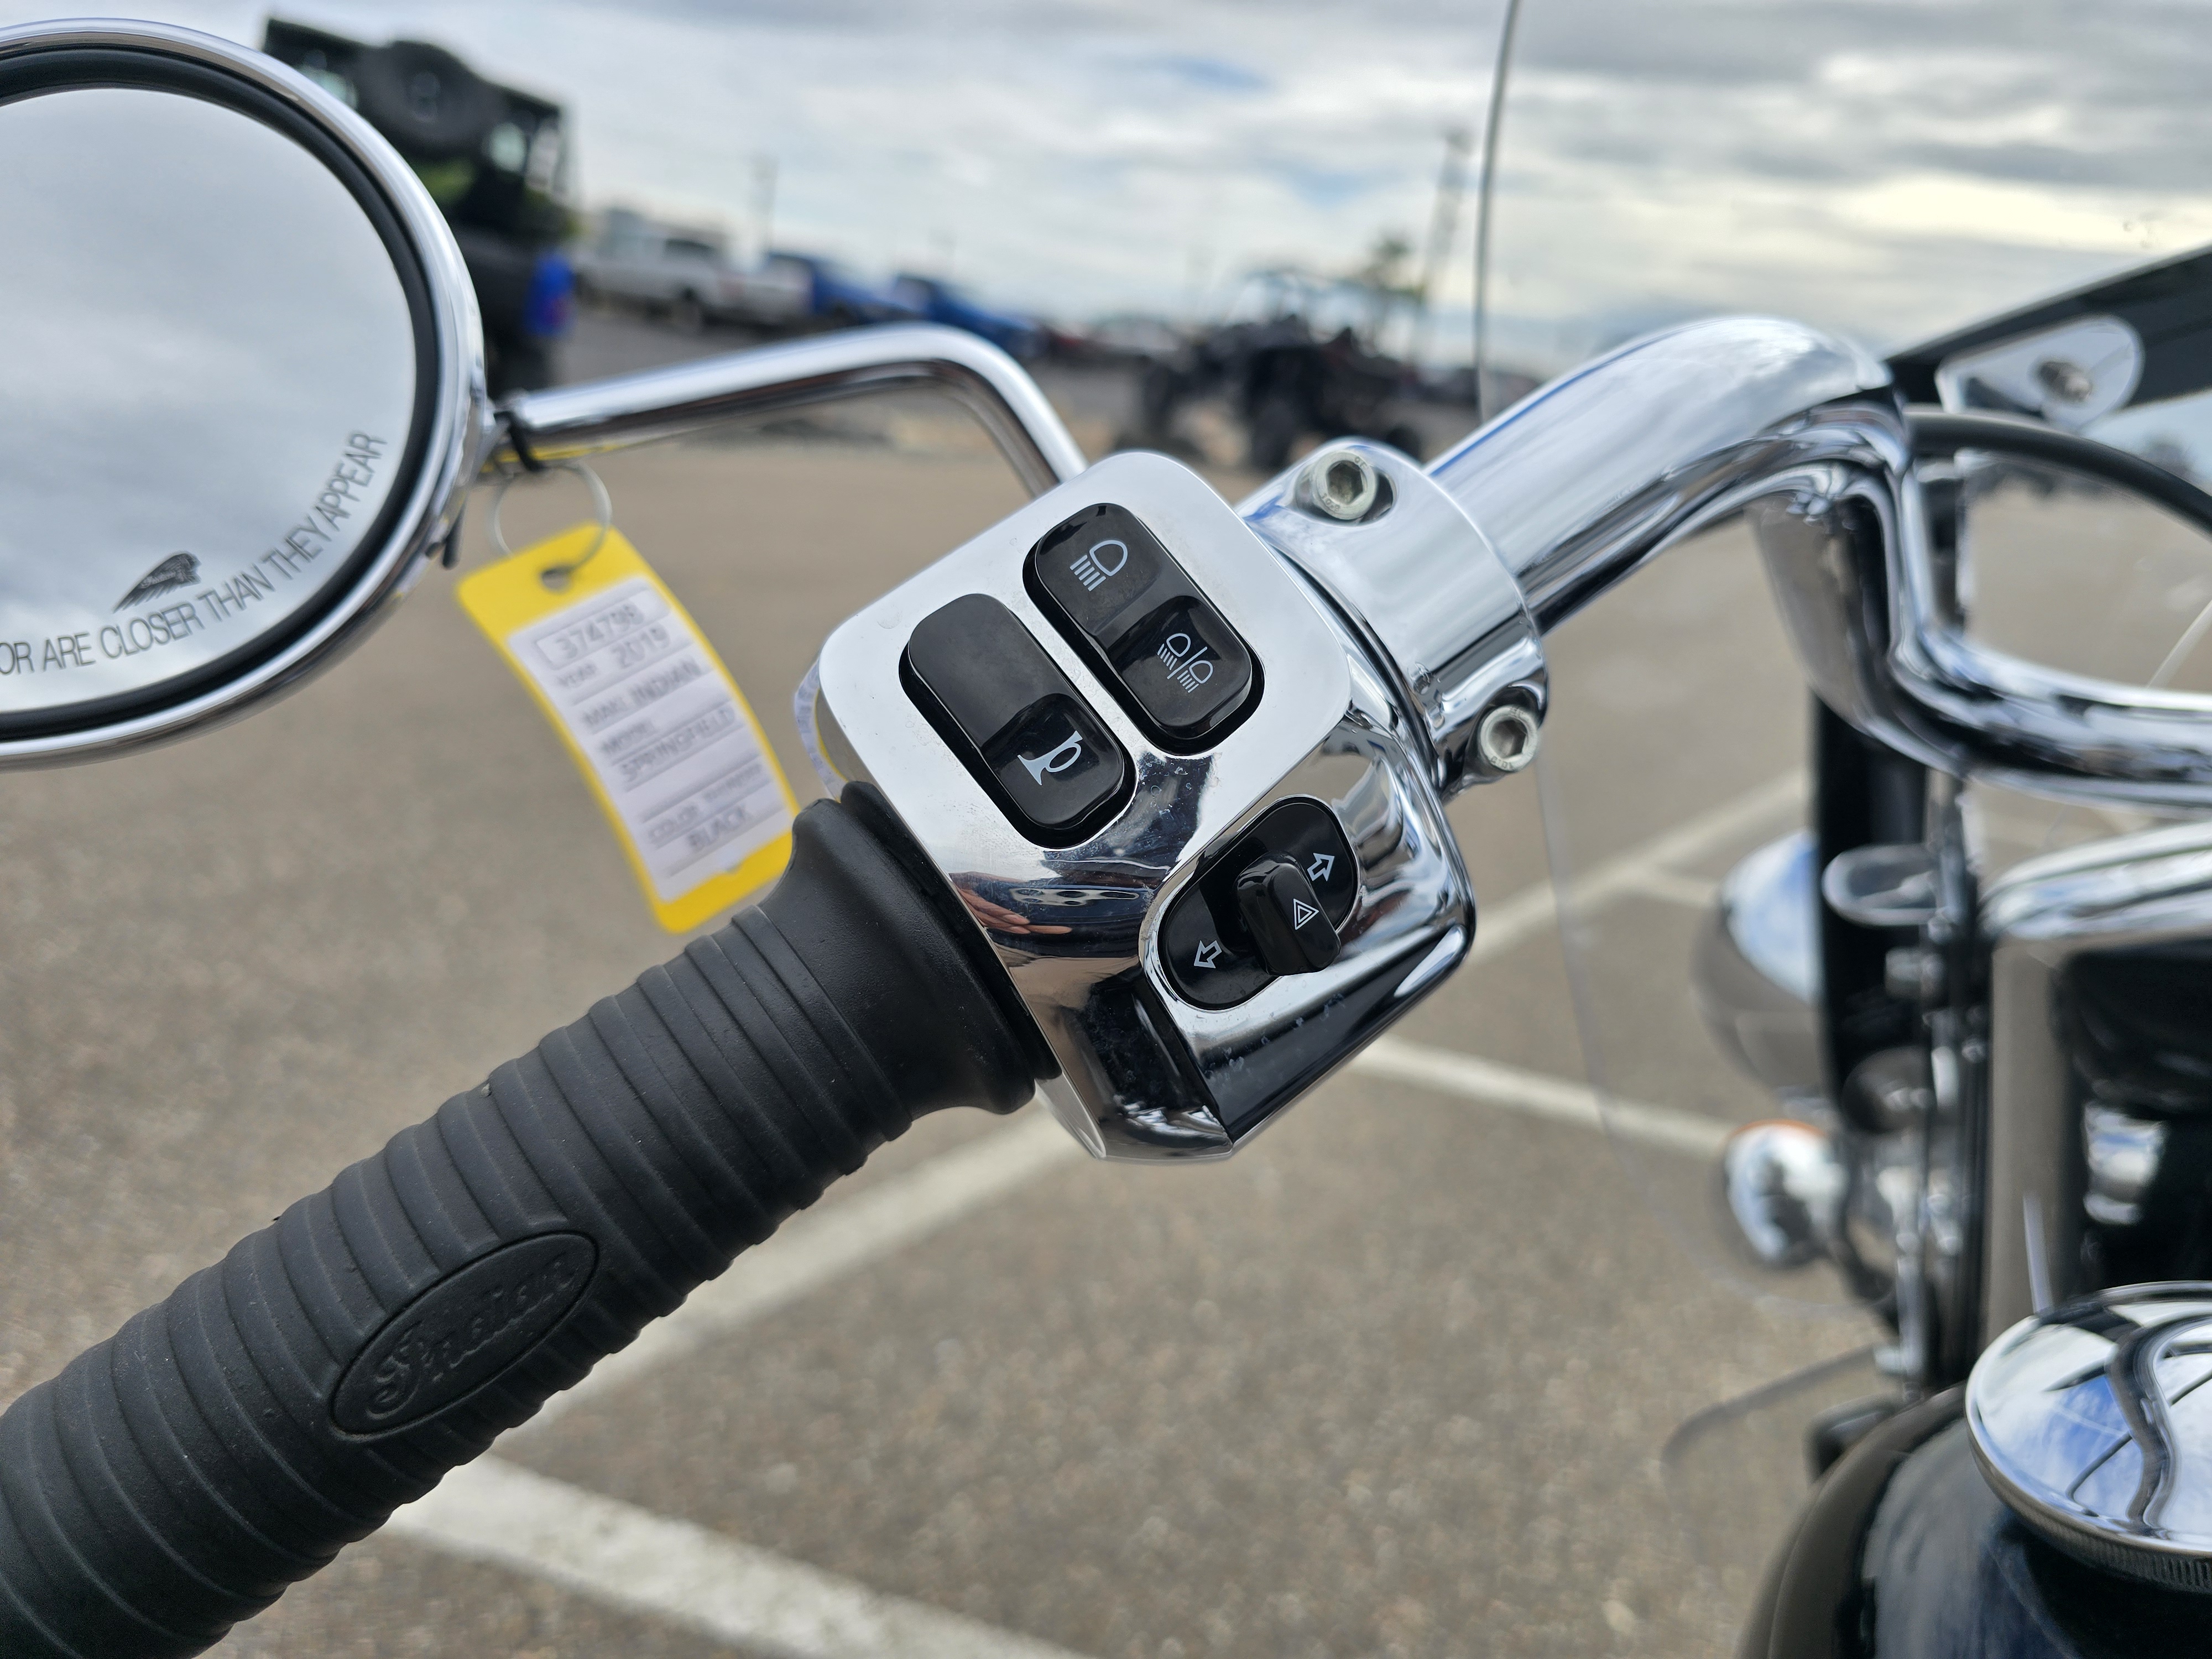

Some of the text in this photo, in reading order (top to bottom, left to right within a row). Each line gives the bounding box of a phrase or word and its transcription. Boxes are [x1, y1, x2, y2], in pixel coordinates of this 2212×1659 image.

[42, 633, 95, 672] ARE
[100, 602, 205, 660] CLOSER
[197, 563, 275, 623] THAN
[262, 514, 333, 581] THEY
[315, 431, 387, 531] APPEAR
[609, 622, 674, 670] 2019
[628, 655, 703, 708] INDIAN
[684, 802, 755, 853] BLACK
